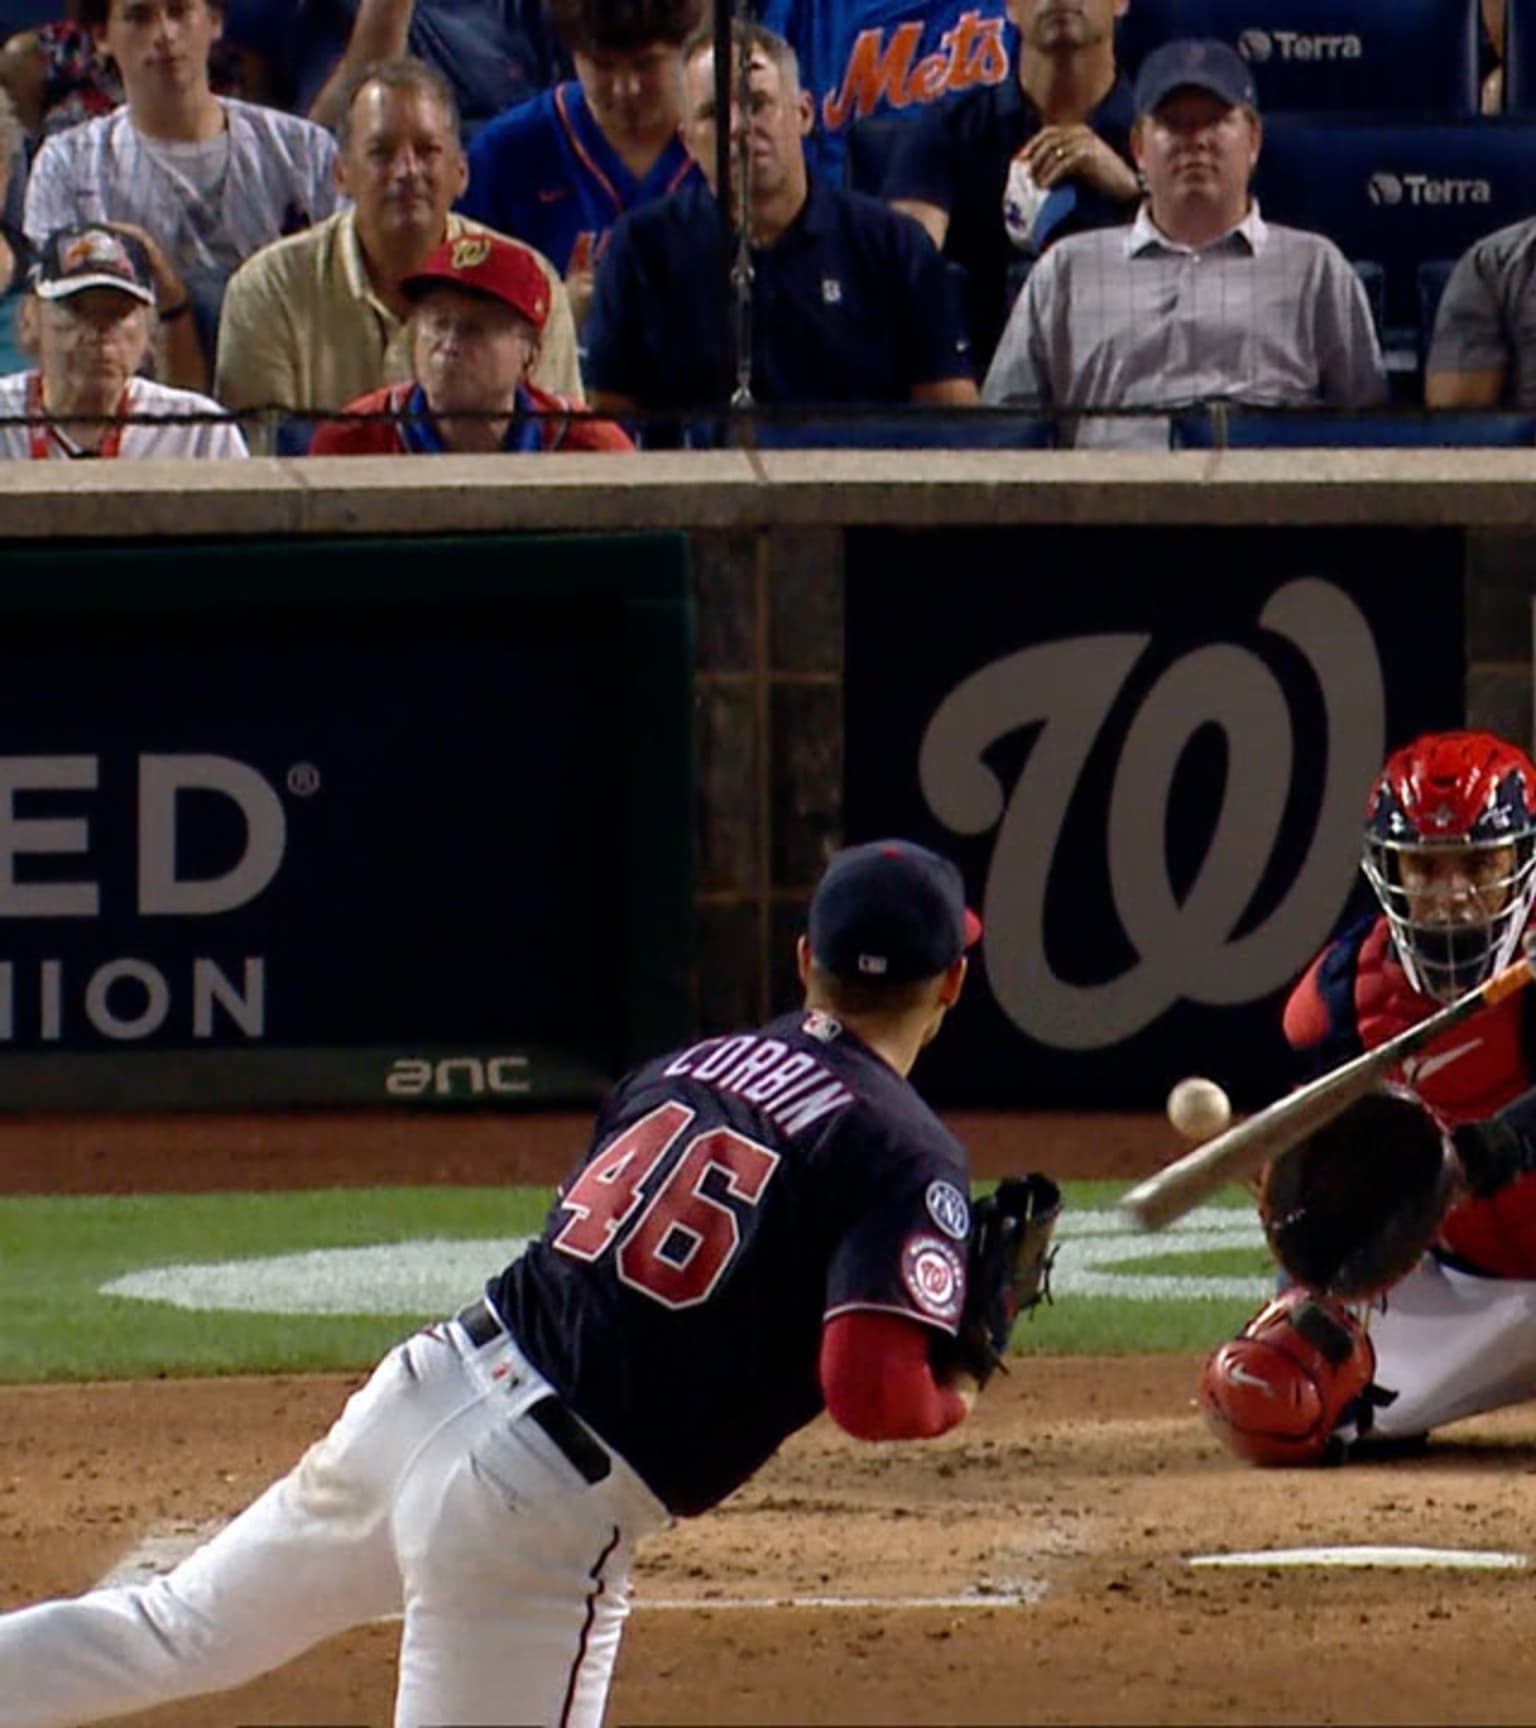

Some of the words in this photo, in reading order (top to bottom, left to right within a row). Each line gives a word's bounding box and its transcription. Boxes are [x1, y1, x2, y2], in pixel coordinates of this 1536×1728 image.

[823, 9, 1009, 129] Mets
[1275, 31, 1361, 60] Terra
[1404, 174, 1490, 204] Terra
[919, 577, 1386, 1050] W
[386, 1057, 530, 1095] anc
[662, 1035, 855, 1136] CORBIN
[552, 1099, 782, 1310] 46
